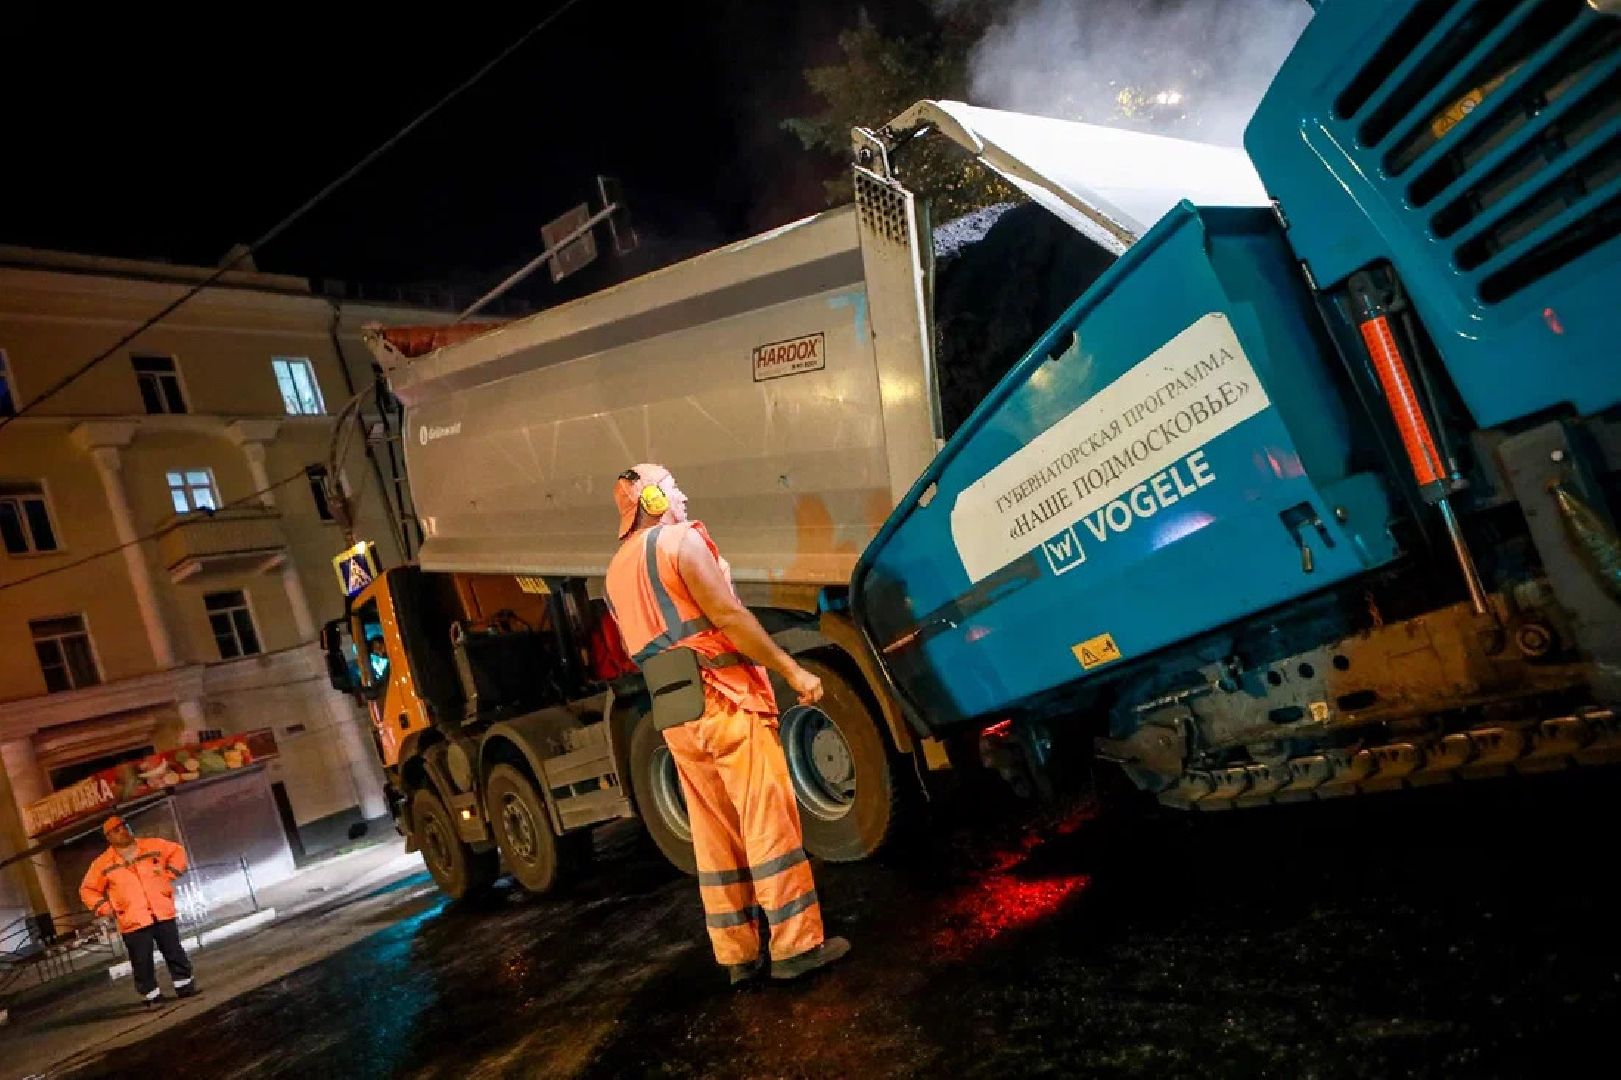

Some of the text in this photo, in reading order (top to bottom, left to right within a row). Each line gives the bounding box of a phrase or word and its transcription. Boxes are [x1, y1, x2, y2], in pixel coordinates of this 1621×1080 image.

[757, 339, 818, 369] HARDOX
[994, 347, 1235, 514] ГУБЕРНАТОРСКАЯ ПРОГРАММА
[1008, 381, 1250, 540] «НАШЕ ПОДМОСКОВЬЕ»
